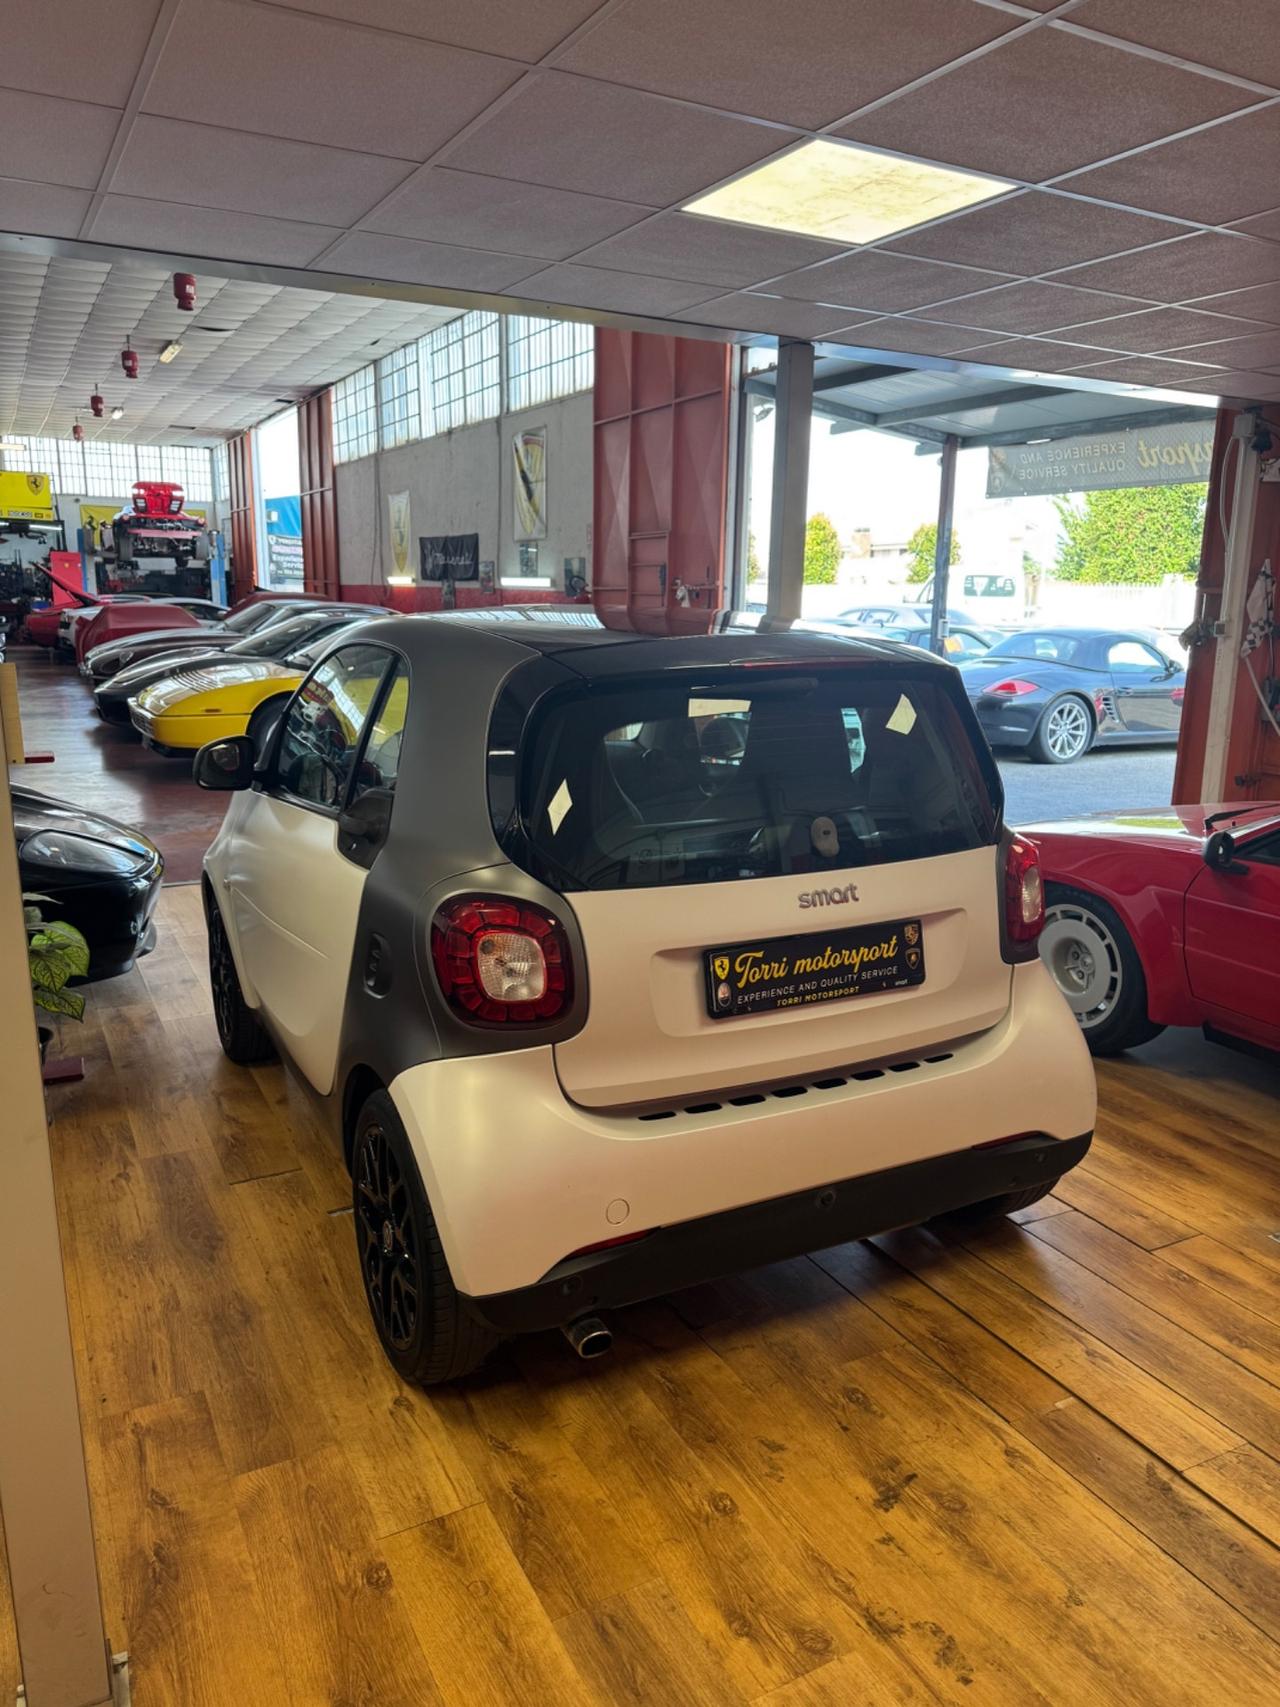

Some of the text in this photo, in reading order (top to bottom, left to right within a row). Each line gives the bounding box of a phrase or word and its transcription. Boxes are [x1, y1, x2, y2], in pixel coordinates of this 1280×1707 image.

[798, 883, 859, 909] smart
[735, 935, 898, 989] Torri motorsport
[737, 966, 898, 1004] EXPERIENCE AND QUALITY SERVICE
[776, 986, 860, 1007] TORRI MOTORSPORT
